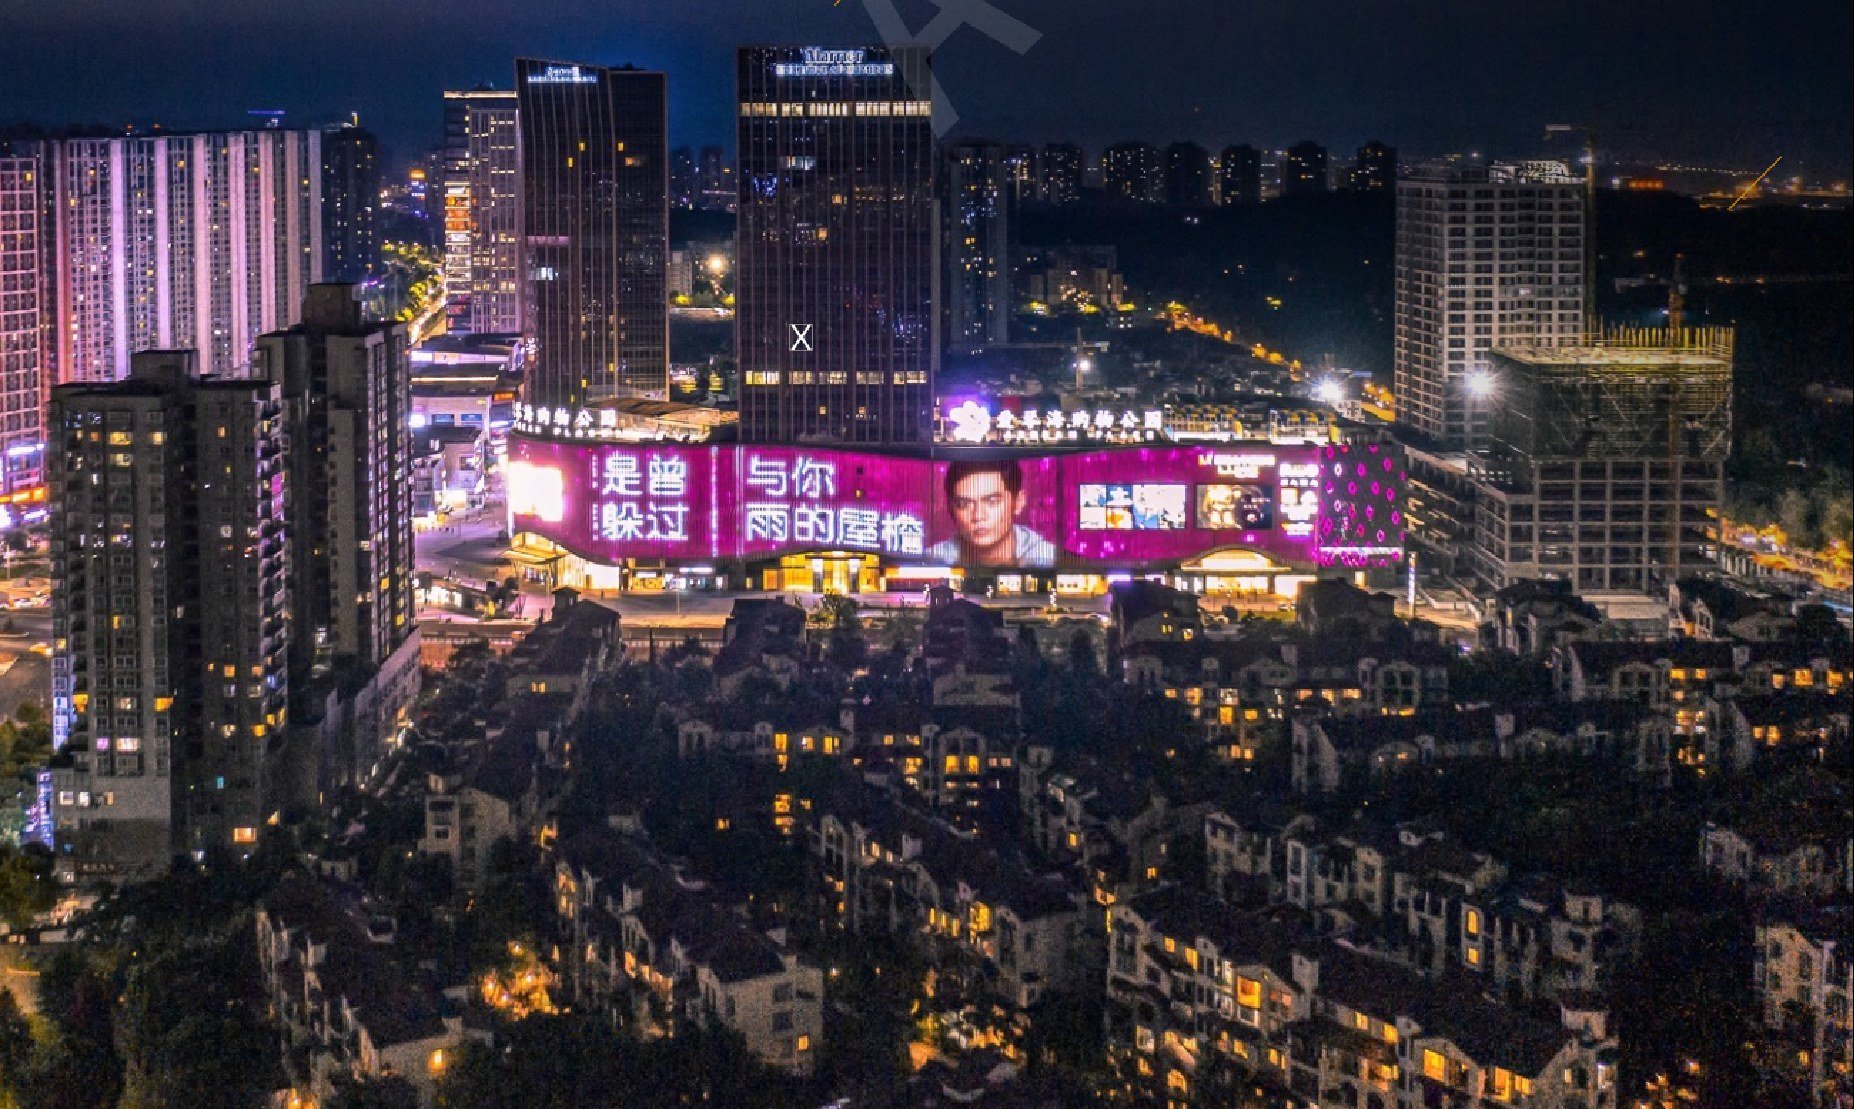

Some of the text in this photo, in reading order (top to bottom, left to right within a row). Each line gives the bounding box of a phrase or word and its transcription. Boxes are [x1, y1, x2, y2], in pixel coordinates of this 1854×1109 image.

[602, 451, 686, 496] 是曾
[747, 454, 835, 498] 与你
[602, 501, 690, 541] 躲过
[746, 502, 923, 554] 雨的屋檐
